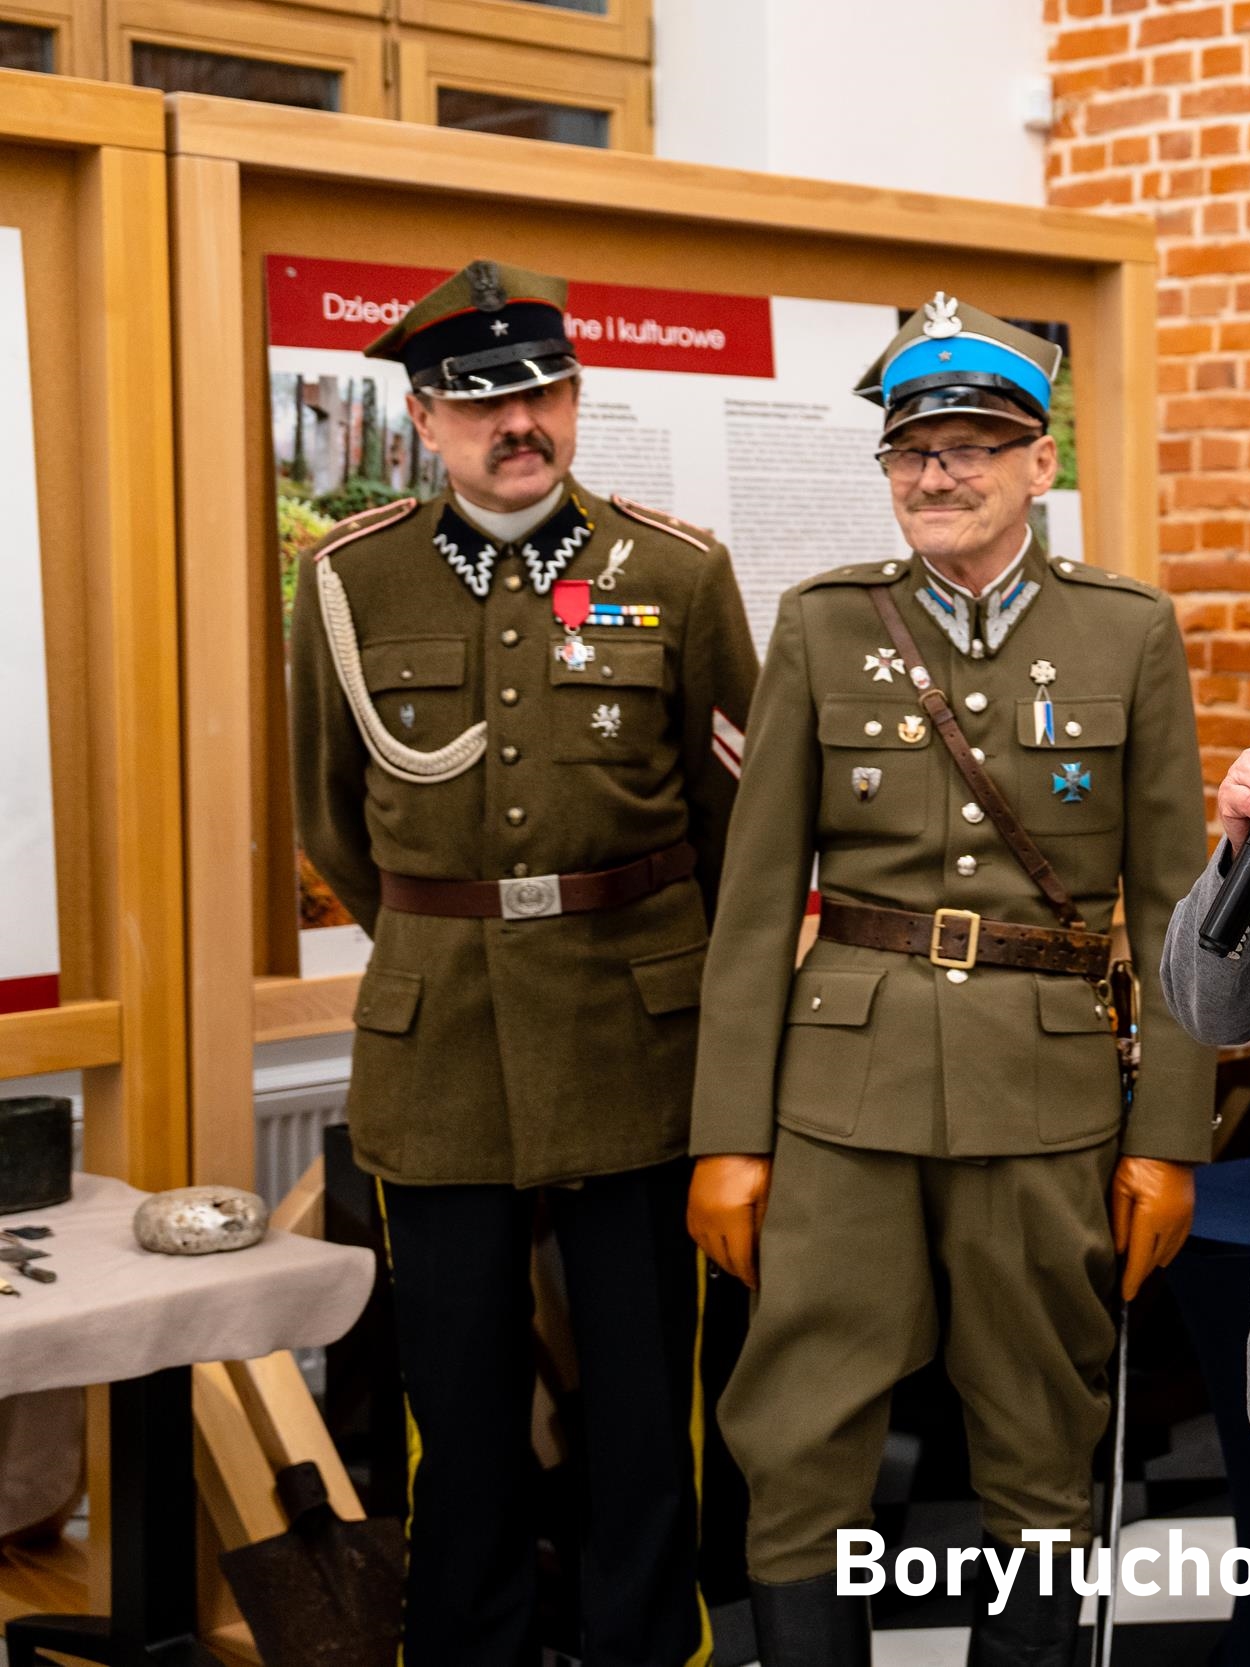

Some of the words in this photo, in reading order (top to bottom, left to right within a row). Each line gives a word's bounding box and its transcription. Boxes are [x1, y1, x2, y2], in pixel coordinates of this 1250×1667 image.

[323, 292, 415, 325] Dziedz
[563, 312, 602, 341] lne
[606, 315, 615, 341] i
[618, 316, 726, 350] kulturowe
